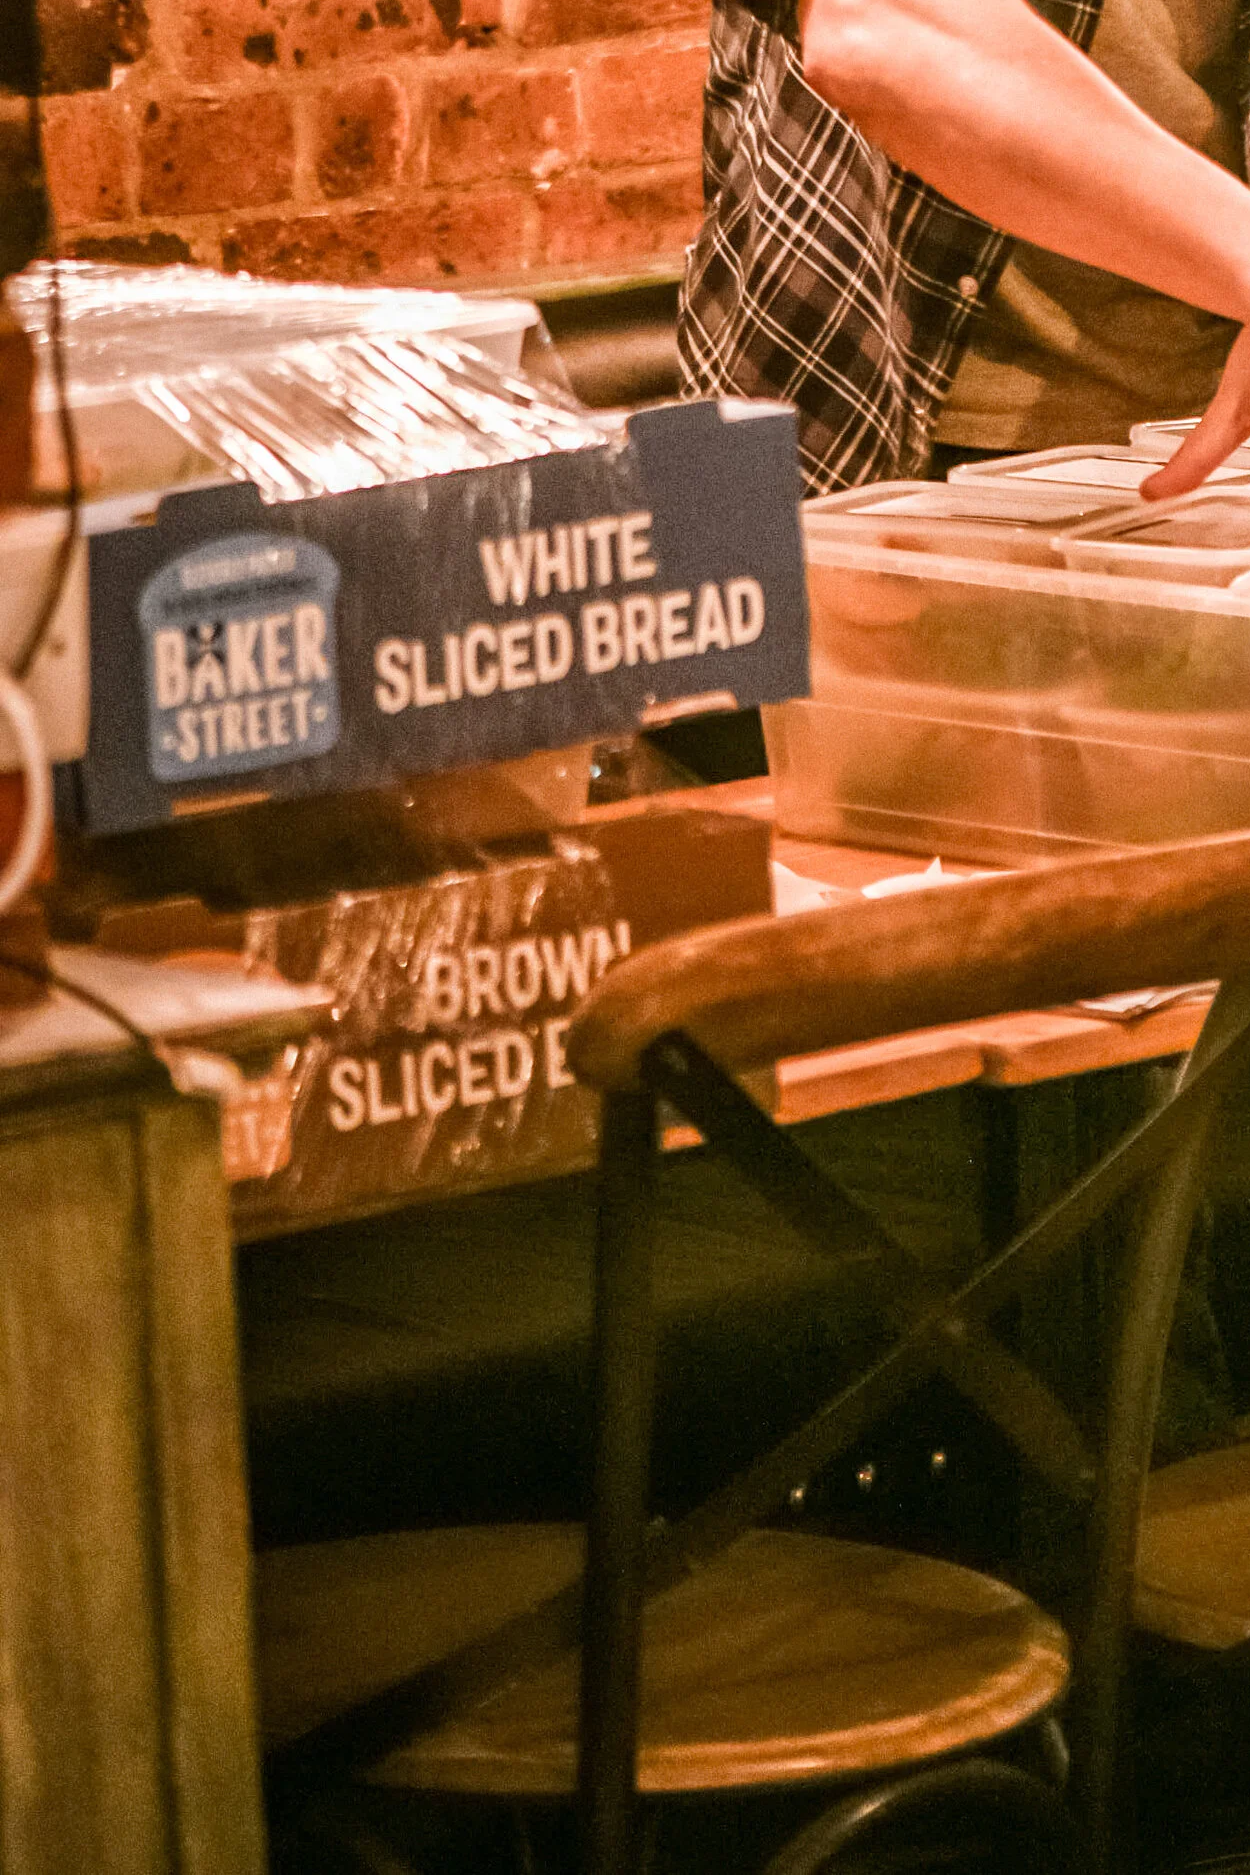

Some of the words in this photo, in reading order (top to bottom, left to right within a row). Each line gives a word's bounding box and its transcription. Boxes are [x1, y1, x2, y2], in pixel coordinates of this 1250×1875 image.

[479, 510, 657, 606] WHITE
[154, 601, 329, 711] BAKER
[373, 611, 574, 715] SLICED
[580, 575, 766, 675] BREAD
[175, 688, 314, 763] STREET
[327, 1028, 536, 1132] SLICED
